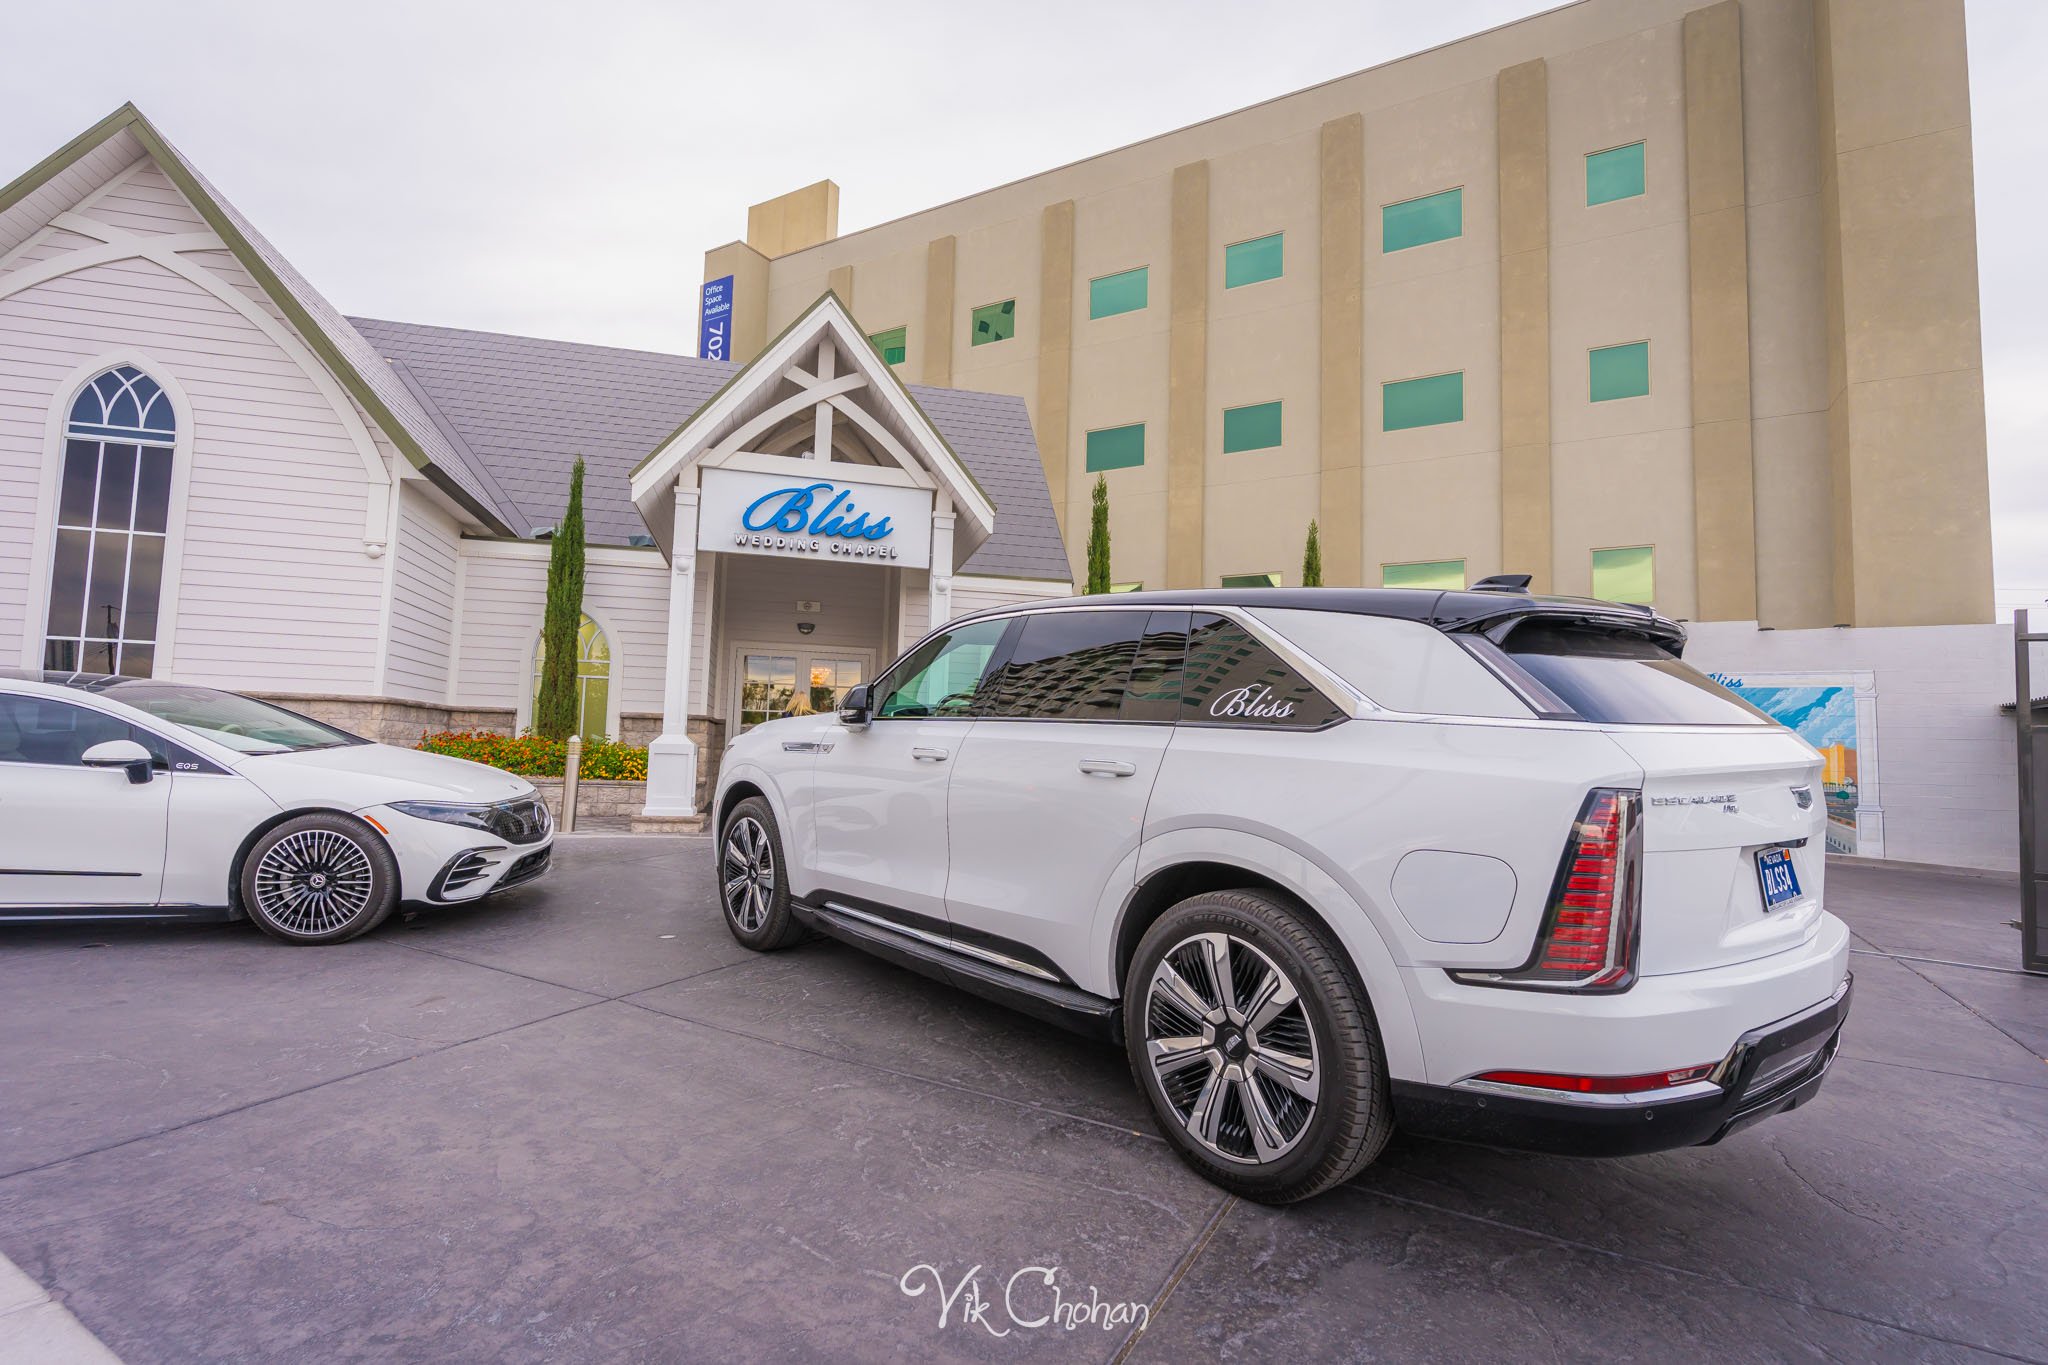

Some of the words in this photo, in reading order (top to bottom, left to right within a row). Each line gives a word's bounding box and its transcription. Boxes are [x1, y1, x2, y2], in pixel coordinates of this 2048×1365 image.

[705, 285, 723, 296] Office
[705, 294, 722, 306] Space
[705, 302, 730, 316] Available
[742, 483, 894, 541] Bliss
[734, 533, 820, 552] WEDDING
[830, 541, 900, 560] CHAPEL
[1209, 683, 1295, 718] Bliss
[175, 762, 199, 770] EQS
[1650, 794, 1737, 807] ESCALADE
[1766, 853, 1782, 865] NEVADA
